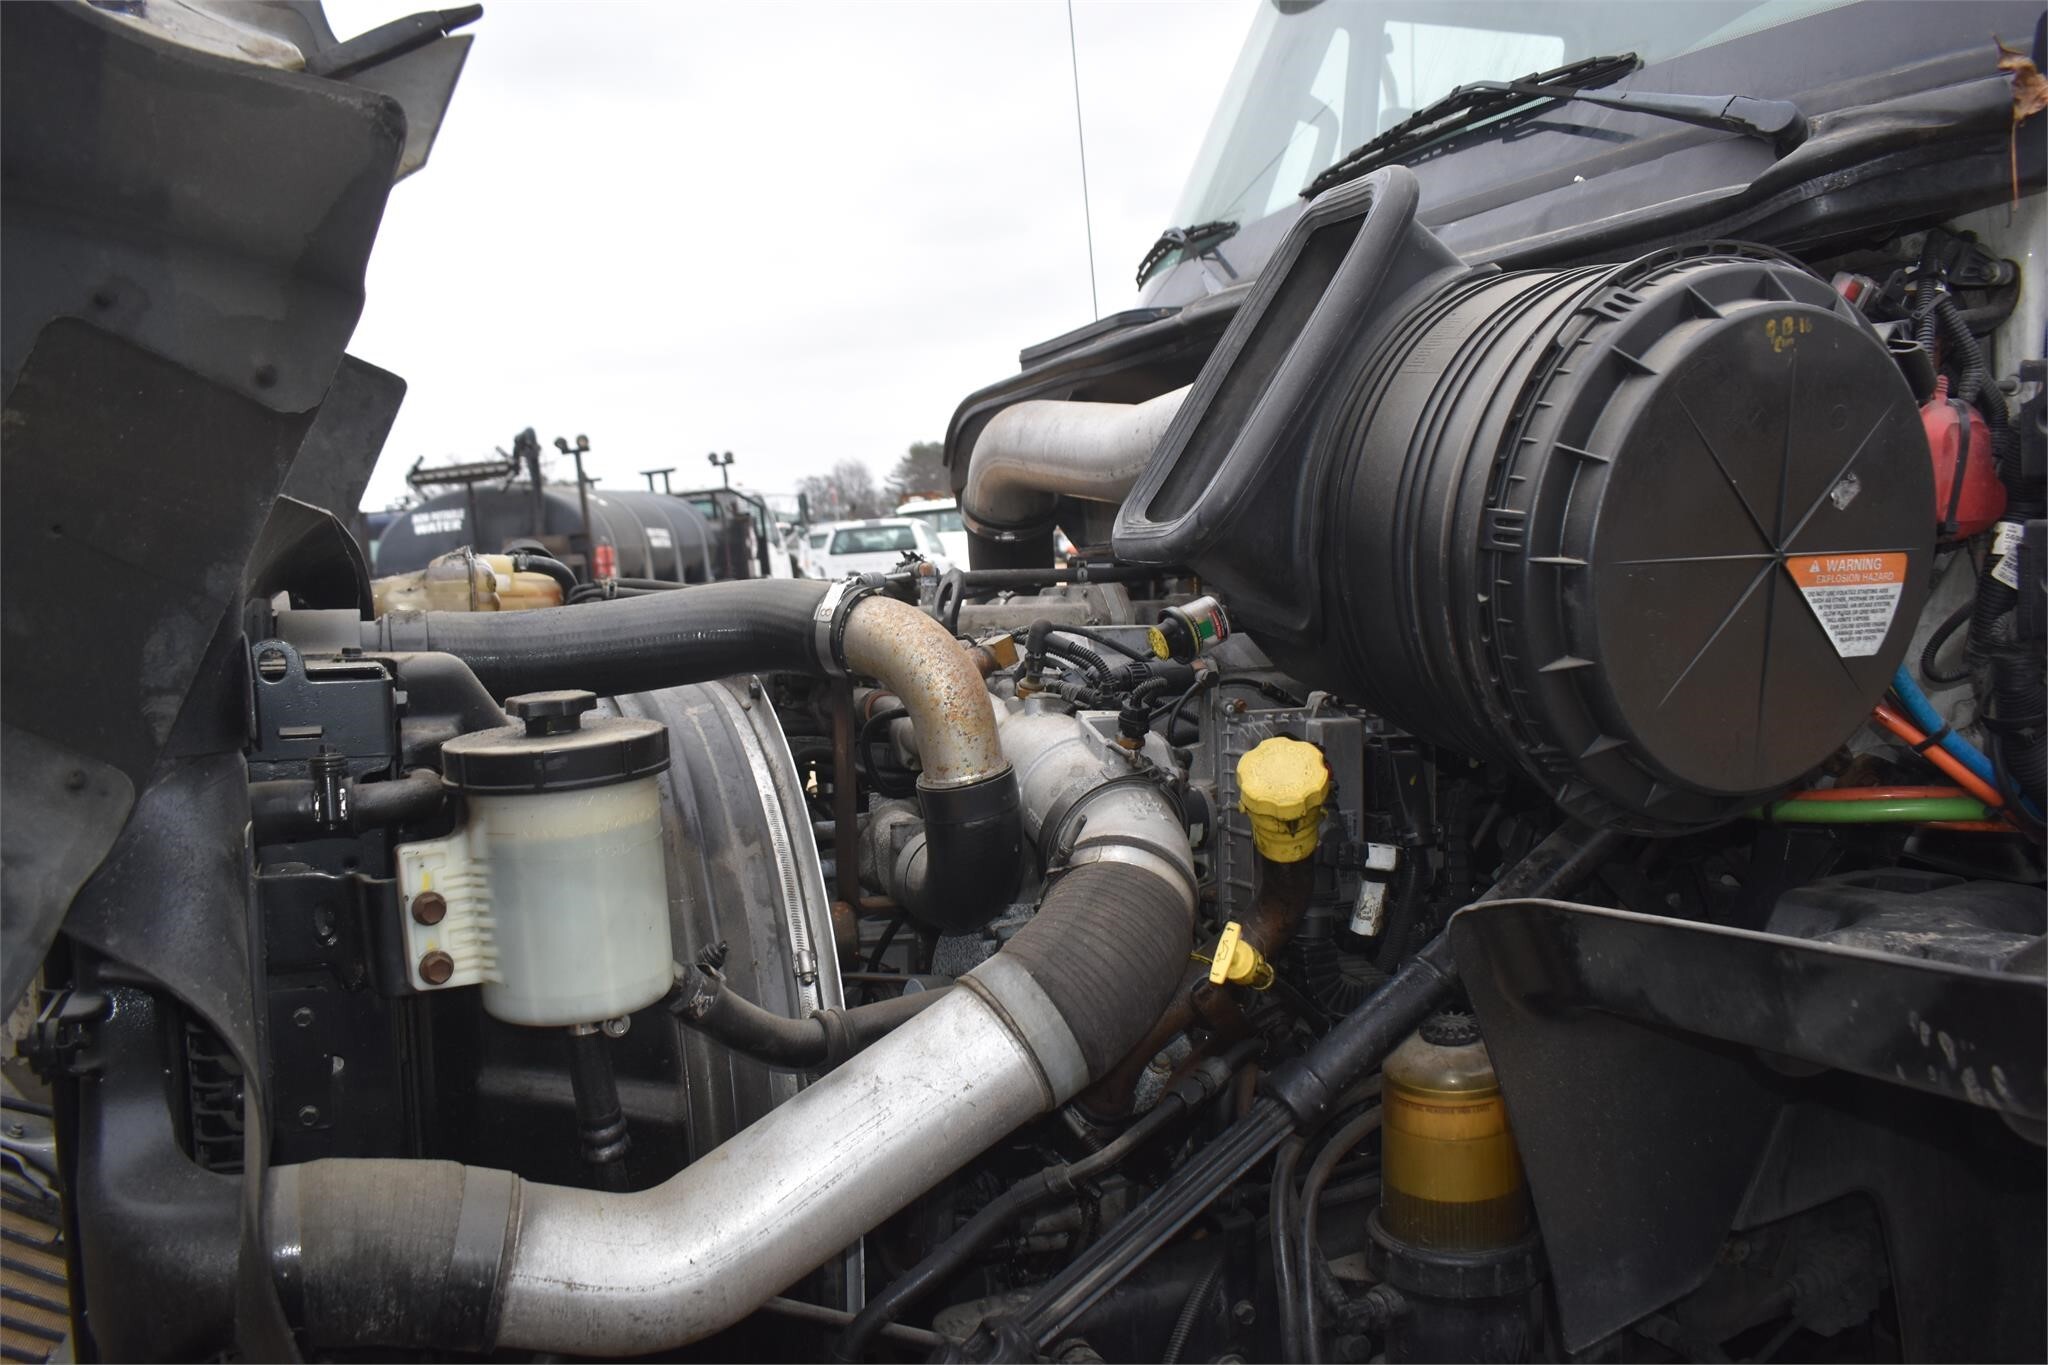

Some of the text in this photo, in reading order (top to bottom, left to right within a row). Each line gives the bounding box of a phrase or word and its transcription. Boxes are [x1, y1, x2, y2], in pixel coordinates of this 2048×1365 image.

[414, 519, 463, 535] WATER
[1826, 557, 1883, 572] WARNING
[1816, 571, 1895, 583] EXPLOSION HAZARD
